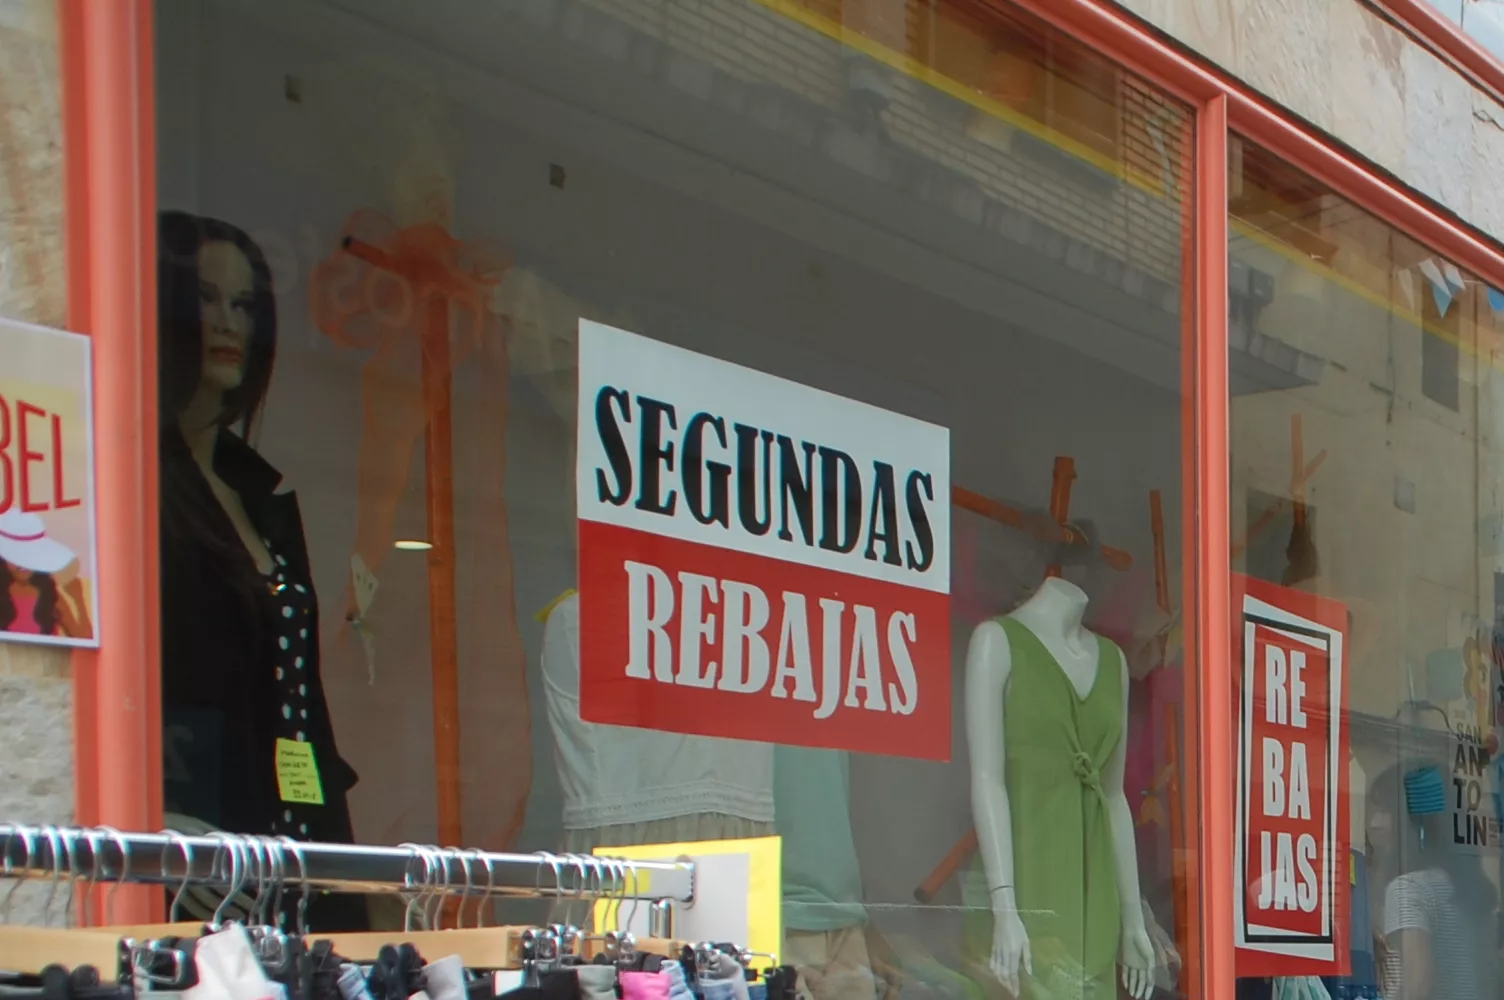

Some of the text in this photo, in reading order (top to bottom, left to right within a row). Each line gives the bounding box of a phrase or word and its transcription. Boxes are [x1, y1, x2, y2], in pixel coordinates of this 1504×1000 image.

[595, 385, 934, 573] SEGUNDAS
[623, 559, 918, 719] REBAJAS
[1264, 643, 1307, 729] RE
[1262, 736, 1311, 820] BA
[1453, 744, 1483, 777] AN
[1257, 830, 1318, 913] JAS
